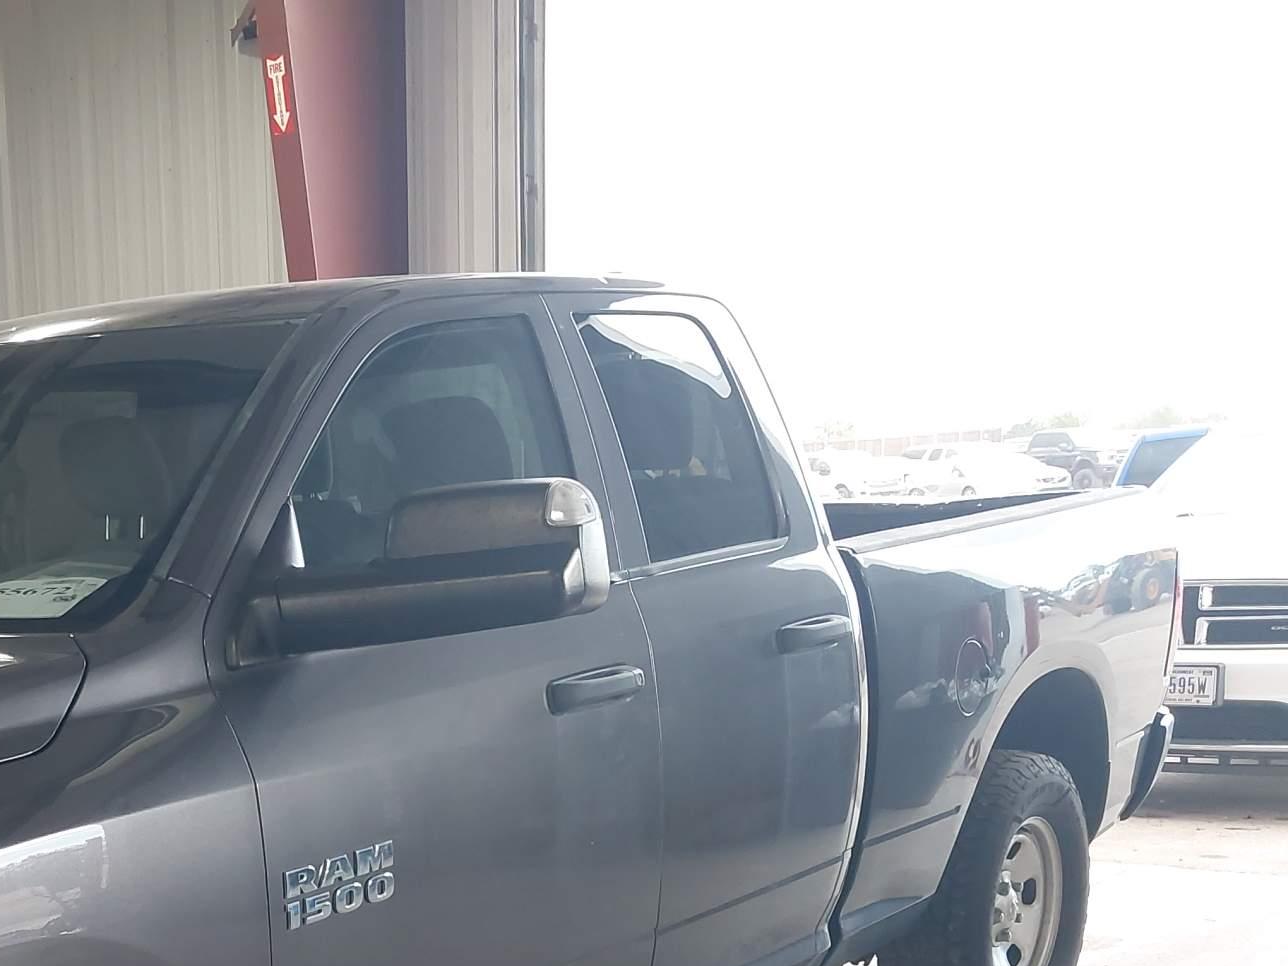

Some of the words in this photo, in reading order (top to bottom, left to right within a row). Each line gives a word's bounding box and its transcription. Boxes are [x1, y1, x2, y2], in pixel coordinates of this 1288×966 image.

[268, 62, 283, 75] FIRE
[1169, 676, 1207, 694] 595W
[282, 840, 394, 899] RAM
[284, 872, 395, 930] 1500
